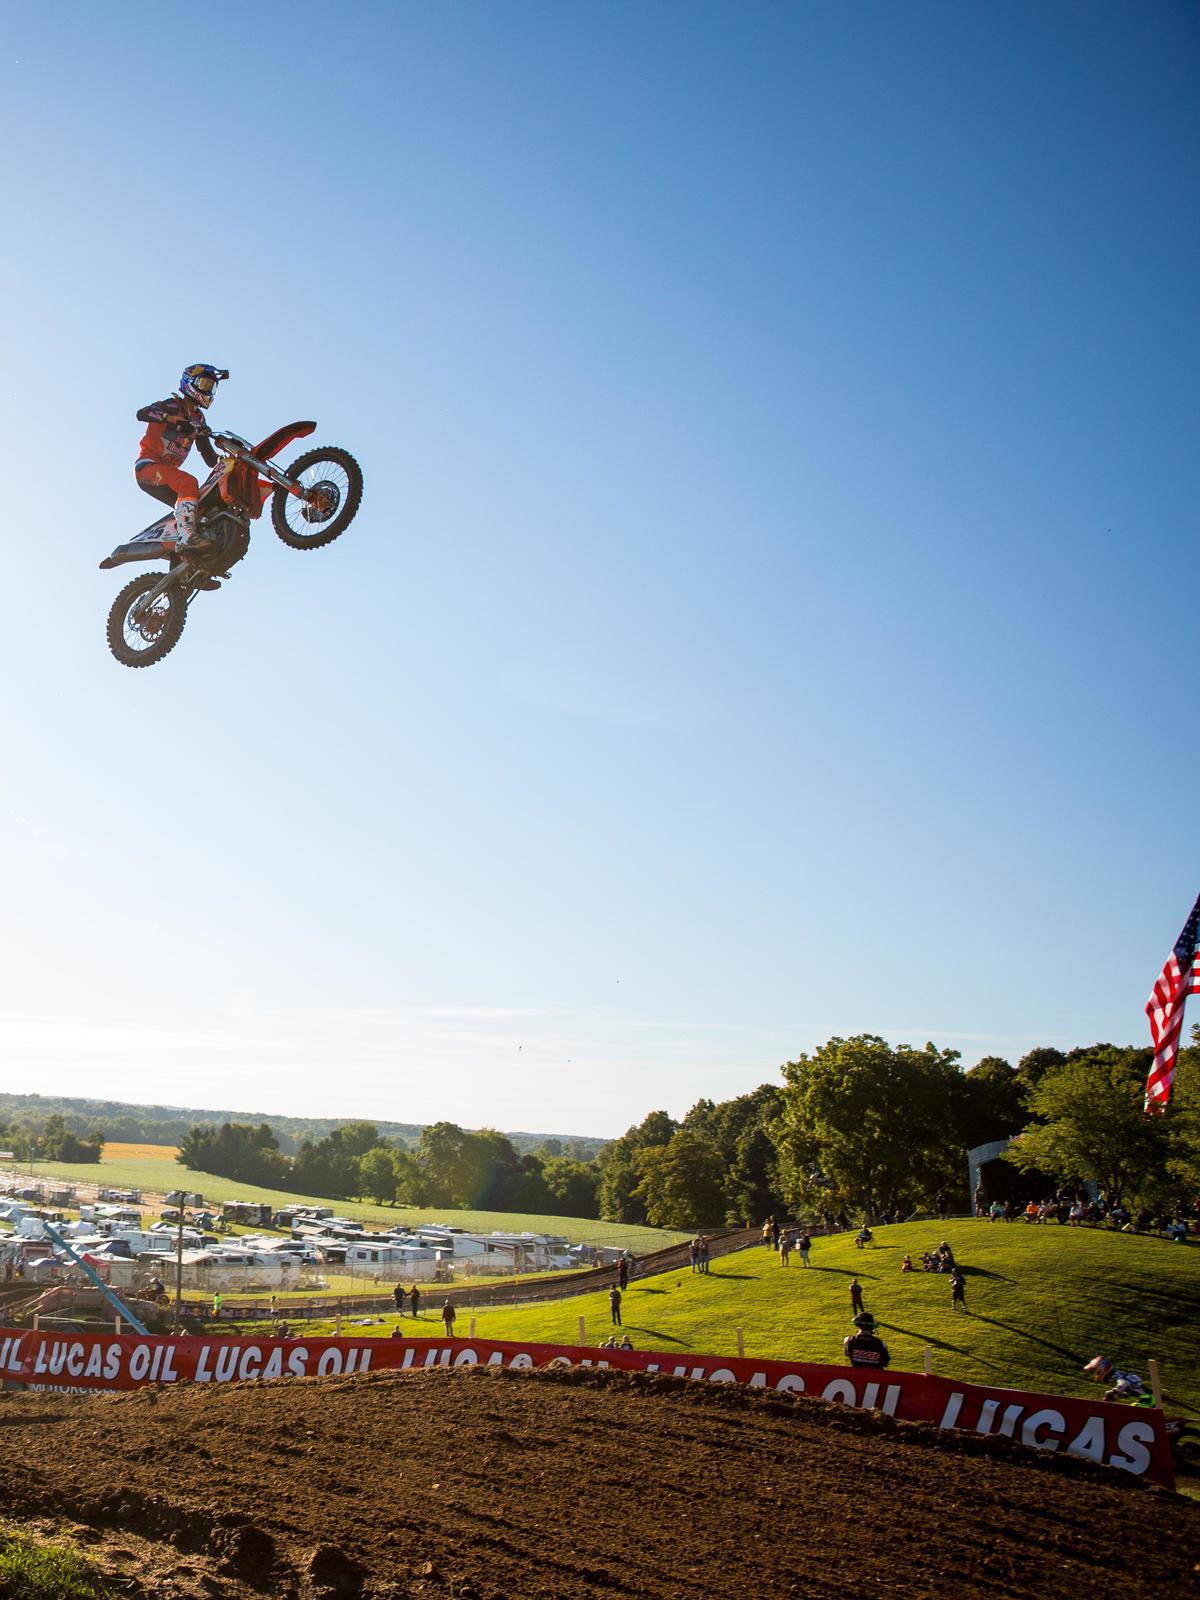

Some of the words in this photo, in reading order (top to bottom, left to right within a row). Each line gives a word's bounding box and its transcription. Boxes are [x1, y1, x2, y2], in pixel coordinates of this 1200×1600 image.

[34, 1340, 121, 1380] LUCAS
[129, 1344, 179, 1382] OIL
[194, 1345, 309, 1383] LUCAS
